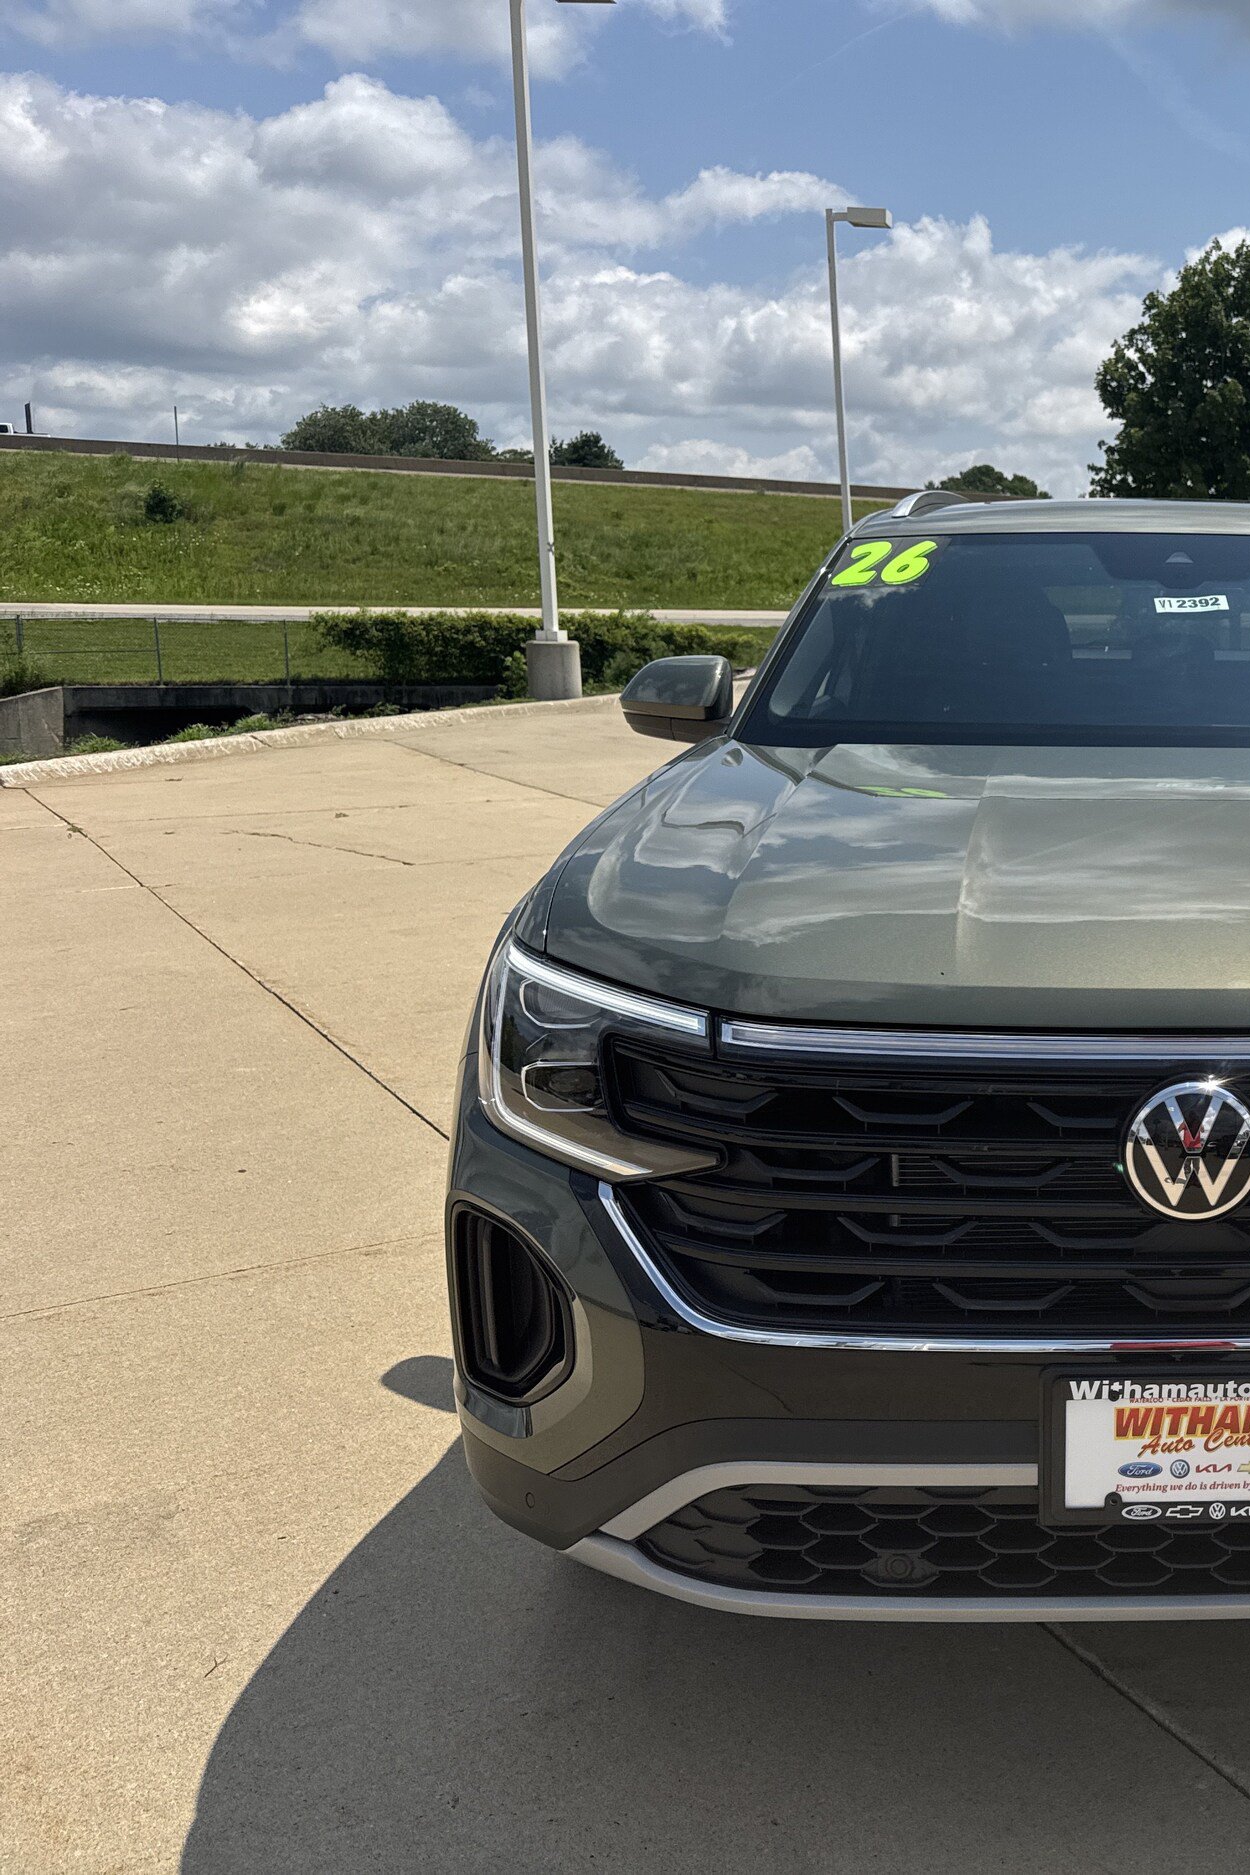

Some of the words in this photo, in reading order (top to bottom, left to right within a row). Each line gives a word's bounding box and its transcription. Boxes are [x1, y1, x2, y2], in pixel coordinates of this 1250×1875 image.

[831, 540, 938, 587] 26
[1176, 597, 1221, 608] 2392
[1137, 1434, 1195, 1458] Auto
[1195, 1463, 1233, 1474] KIA
[1115, 1482, 1168, 1494] Everything
[1169, 1483, 1184, 1491] we
[1185, 1482, 1198, 1491] do
[1199, 1481, 1208, 1490] is
[1209, 1480, 1241, 1490] driven
